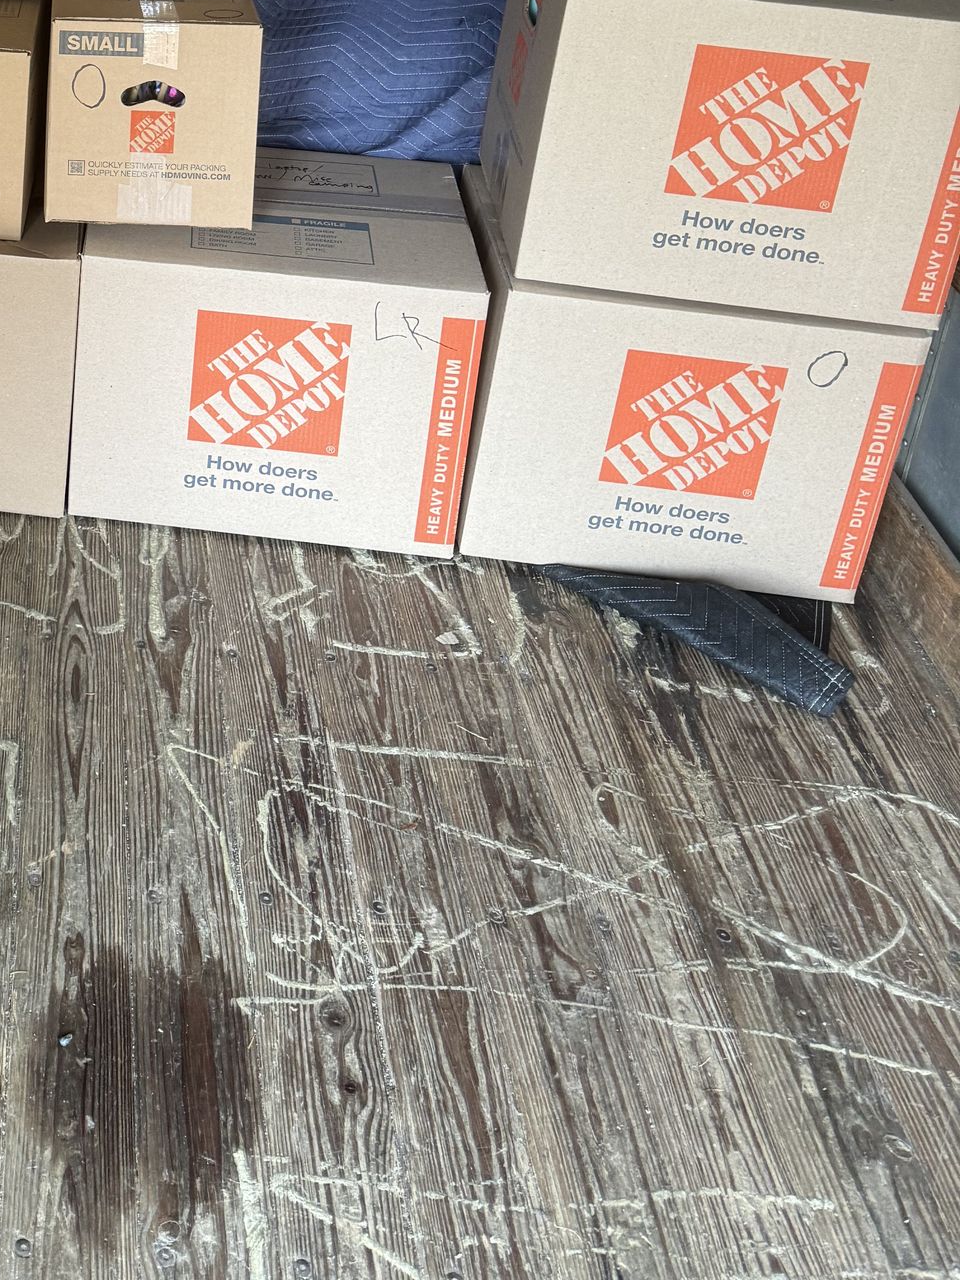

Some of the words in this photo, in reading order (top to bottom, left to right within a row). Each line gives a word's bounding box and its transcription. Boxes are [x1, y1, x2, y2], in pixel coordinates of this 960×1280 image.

[67, 35, 138, 53] SMALL
[699, 66, 779, 125] THE
[130, 110, 175, 152] HOME
[135, 115, 154, 132] THE
[147, 127, 174, 153] DEPOT
[671, 58, 866, 198] HOME
[88, 160, 122, 169] QUICKLY
[125, 162, 163, 170] ESTIMATE
[164, 163, 189, 171] YOUR
[190, 164, 226, 172] PACKING
[88, 169, 120, 177] SUPPLY
[121, 170, 148, 178] NEEDS
[161, 172, 231, 181] HDMOVING.COM
[732, 117, 851, 204] DEPOT
[652, 228, 691, 249] get
[695, 234, 756, 255] more
[681, 209, 734, 232] How
[739, 217, 806, 241] doers
[917, 250, 944, 304] HEAVY
[934, 199, 959, 244] DUTY
[374, 301, 457, 350] LR
[207, 328, 276, 380] THE
[189, 322, 351, 445] HOME
[437, 359, 462, 437] MEDIUM
[630, 369, 704, 422] THE
[245, 373, 346, 449] DEPOT
[604, 364, 784, 486] HOME
[206, 455, 252, 474] How
[258, 460, 318, 481] doers
[433, 443, 451, 483] DUTY
[662, 415, 774, 492] DEPOT
[183, 475, 217, 492] get
[222, 479, 275, 495] more
[834, 531, 860, 582] HEAVY
[848, 488, 871, 529] DUTY
[861, 404, 897, 484] MEDIUM
[426, 488, 444, 535] HEAVY
[588, 513, 624, 531] get
[628, 518, 685, 537] more
[614, 495, 663, 517] How
[668, 503, 731, 524] doers
